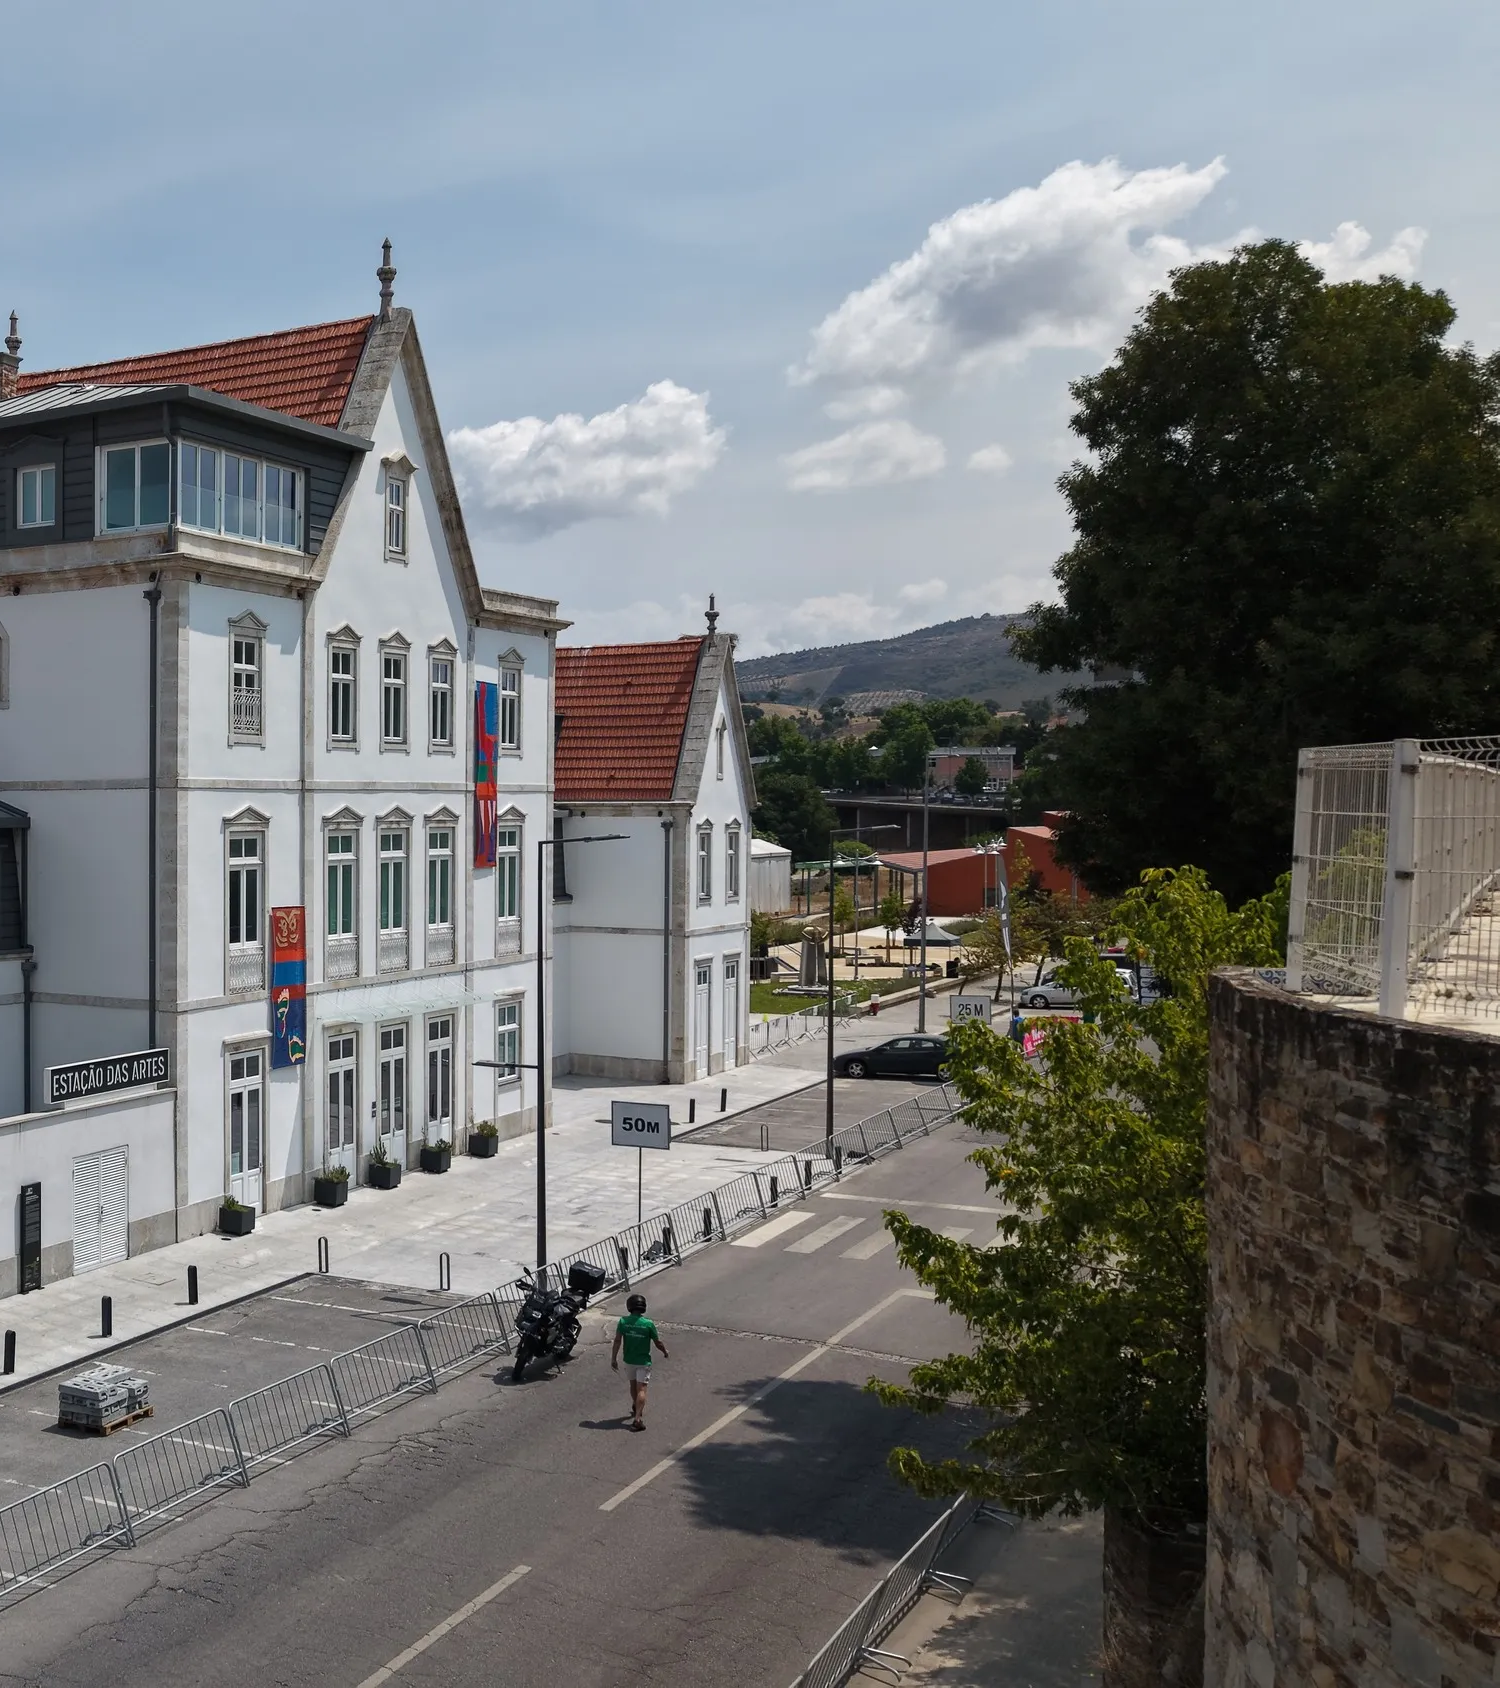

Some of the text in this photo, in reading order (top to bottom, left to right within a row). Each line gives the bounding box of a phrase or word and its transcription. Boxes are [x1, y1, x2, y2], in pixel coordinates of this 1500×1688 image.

[958, 1003, 984, 1017] 25 M
[53, 1056, 165, 1097] ESTAÇÃO DAS ARTES
